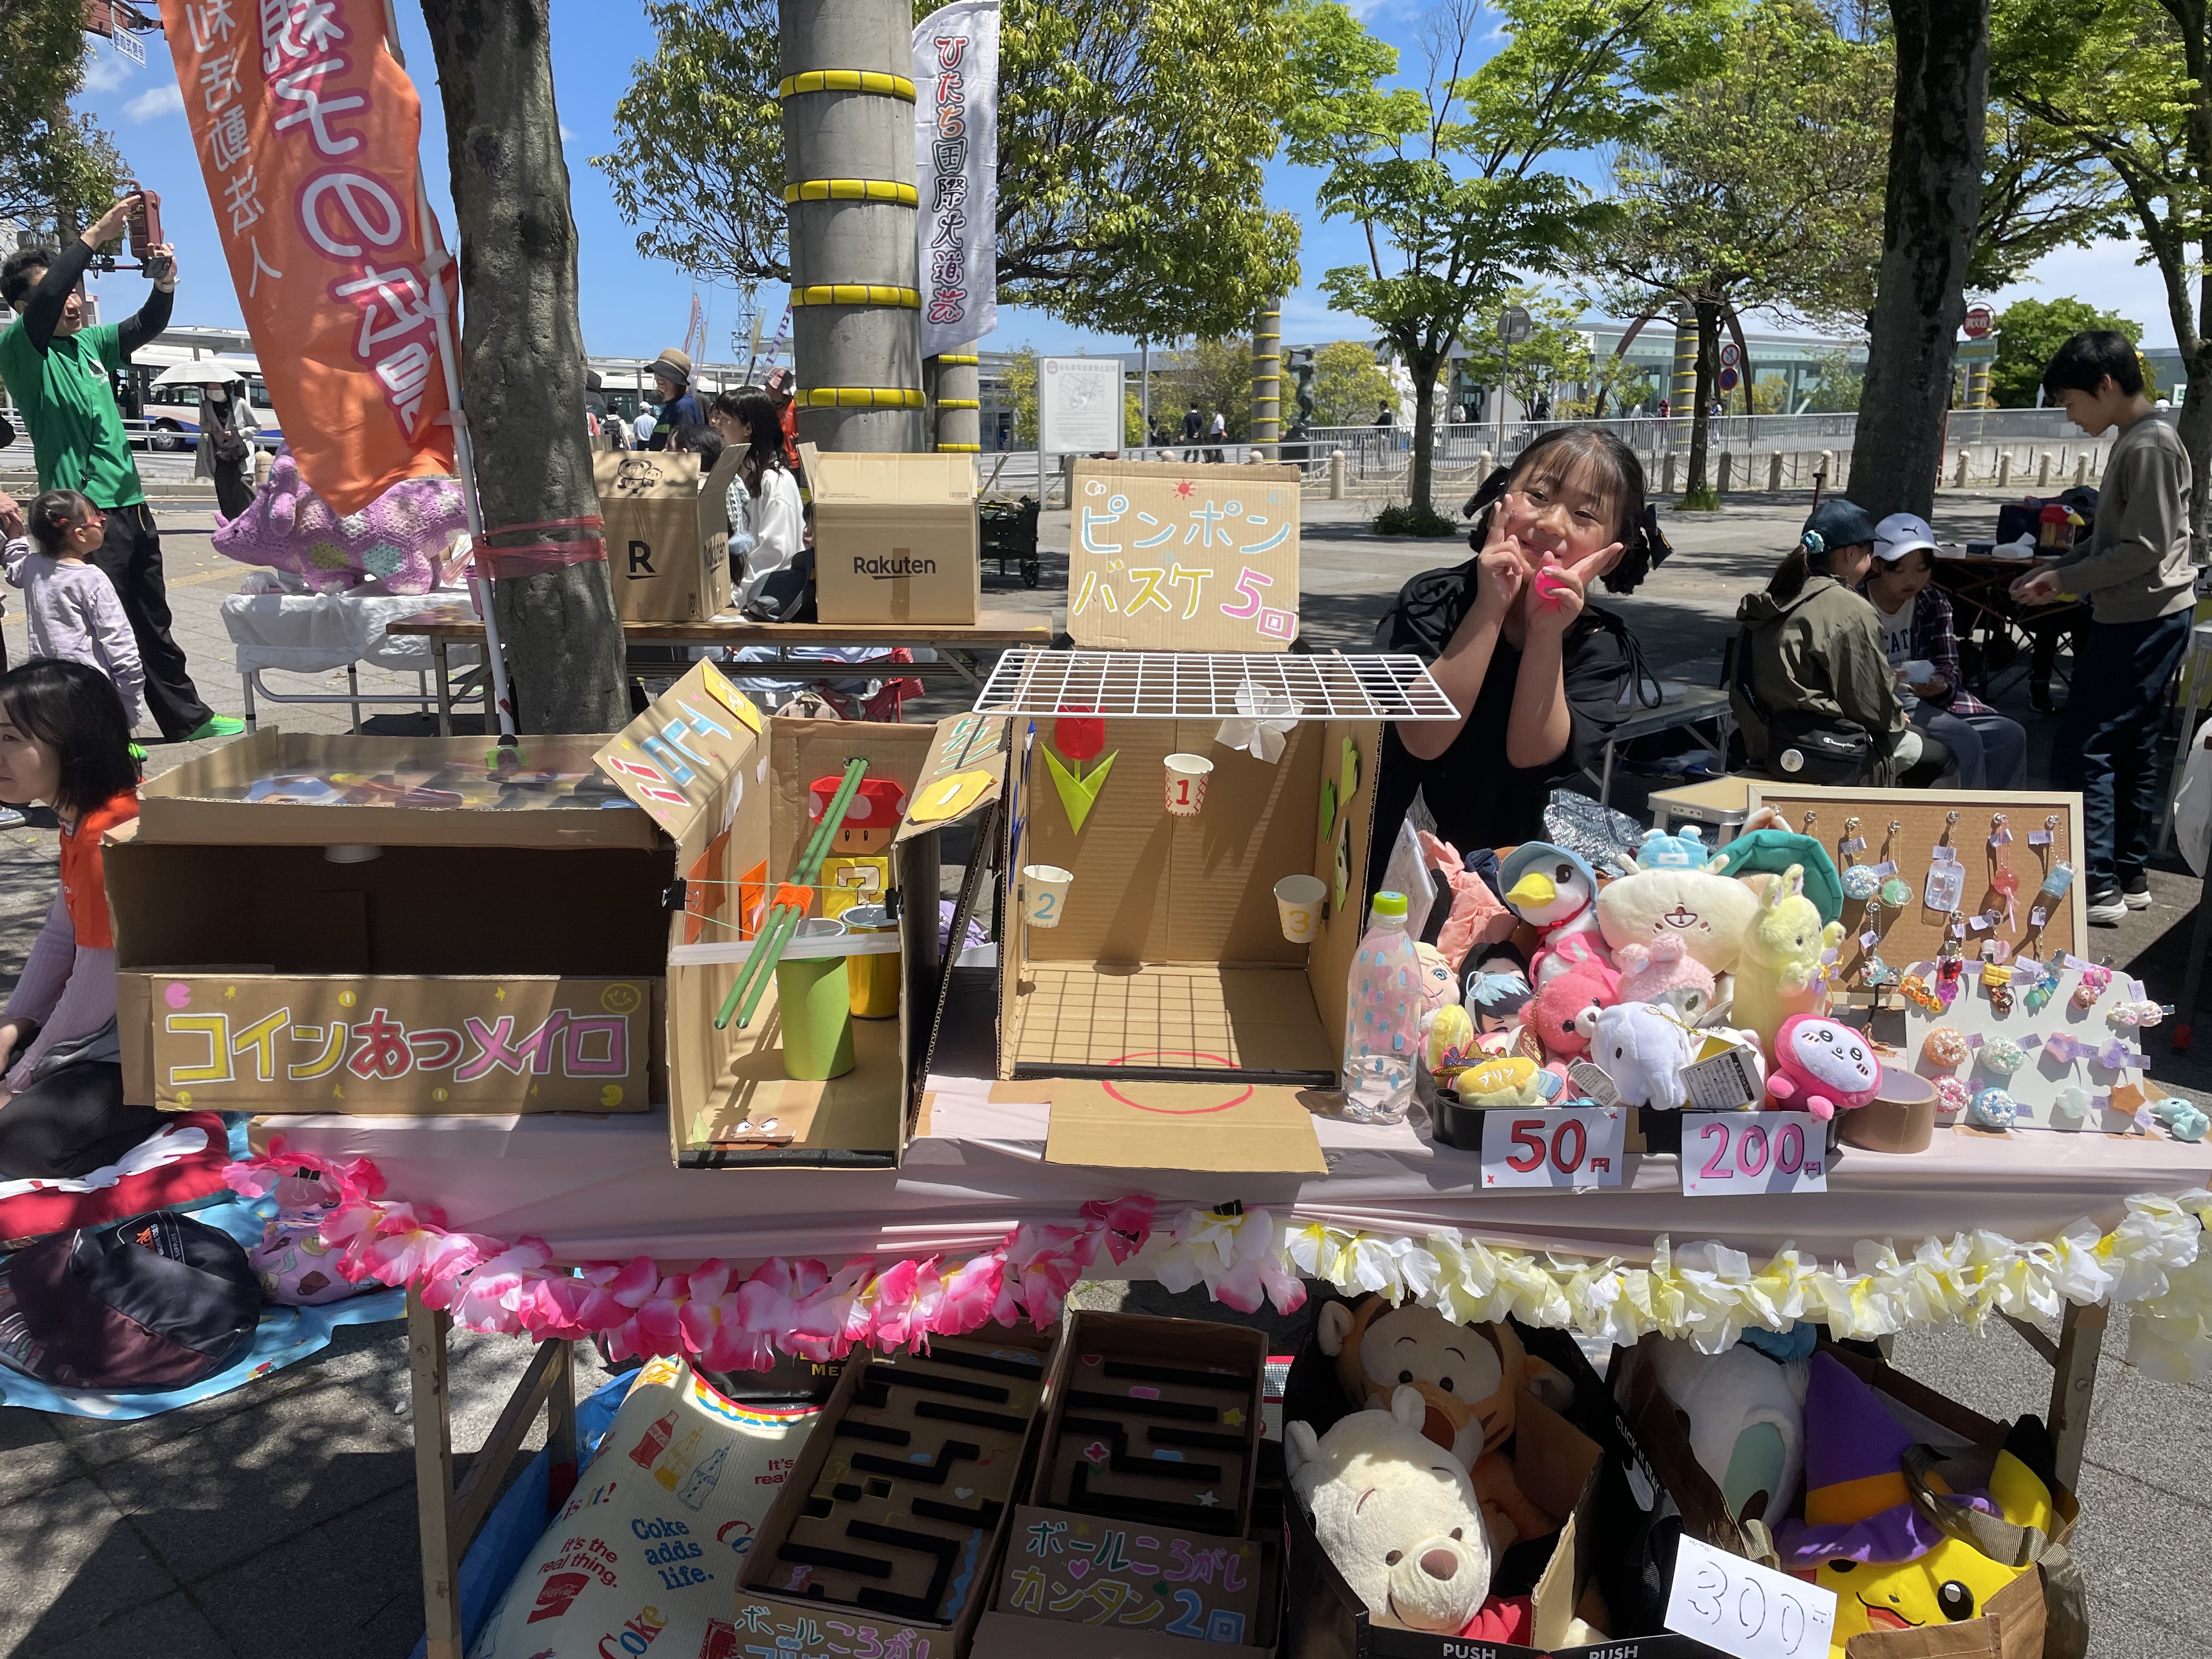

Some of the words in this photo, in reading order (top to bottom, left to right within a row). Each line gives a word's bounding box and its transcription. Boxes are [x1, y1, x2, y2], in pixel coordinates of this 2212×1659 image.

[1081, 494, 1291, 554] ピンポン
[628, 540, 656, 573] R
[703, 540, 726, 570] Rakuten
[854, 556, 936, 575] Rakuten
[1073, 559, 1214, 620] バスケ
[1175, 779, 1190, 805] 1
[1036, 893, 1056, 920] 2
[1289, 910, 1311, 934] 3
[1479, 1068, 1514, 1086] プリン
[1505, 1119, 1611, 1174] 50円
[1699, 1122, 1821, 1180] 200円
[1616, 1415, 1638, 1455] CLICK
[631, 1517, 690, 1541] Coke
[560, 1536, 586, 1554] It's
[588, 1538, 618, 1564] the
[644, 1540, 704, 1566] adds
[1026, 1520, 1249, 1593] ボールころがし
[537, 1554, 571, 1576] real
[572, 1553, 618, 1589] thing.
[658, 1564, 715, 1590] life.
[1442, 1643, 1497, 1659] PUSH
